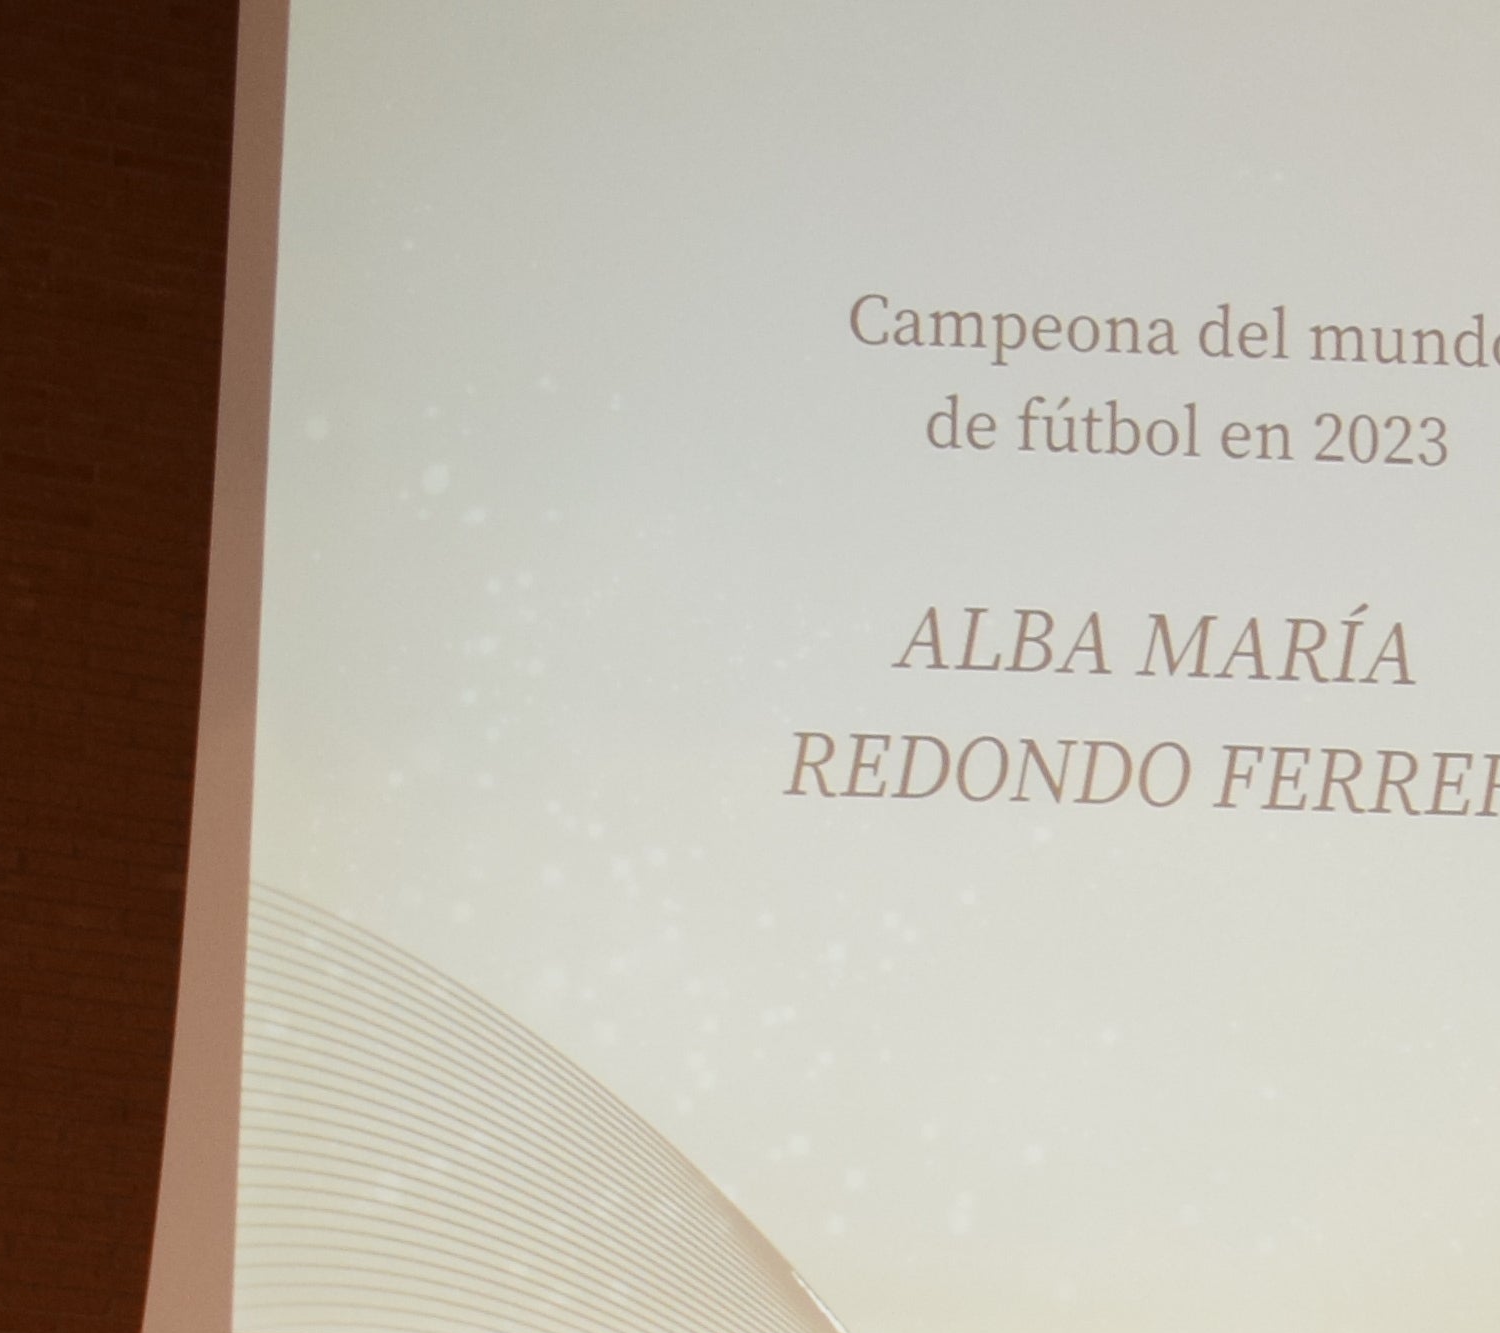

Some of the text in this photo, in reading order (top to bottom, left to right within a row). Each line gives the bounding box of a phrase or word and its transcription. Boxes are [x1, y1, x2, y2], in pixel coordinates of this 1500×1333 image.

[848, 294, 1179, 366] Campeona
[1200, 304, 1290, 359] del
[926, 394, 1449, 467] de fútbol en 2023
[891, 602, 1417, 686] ALBA MARÍA
[783, 731, 1192, 808] REDONDO
